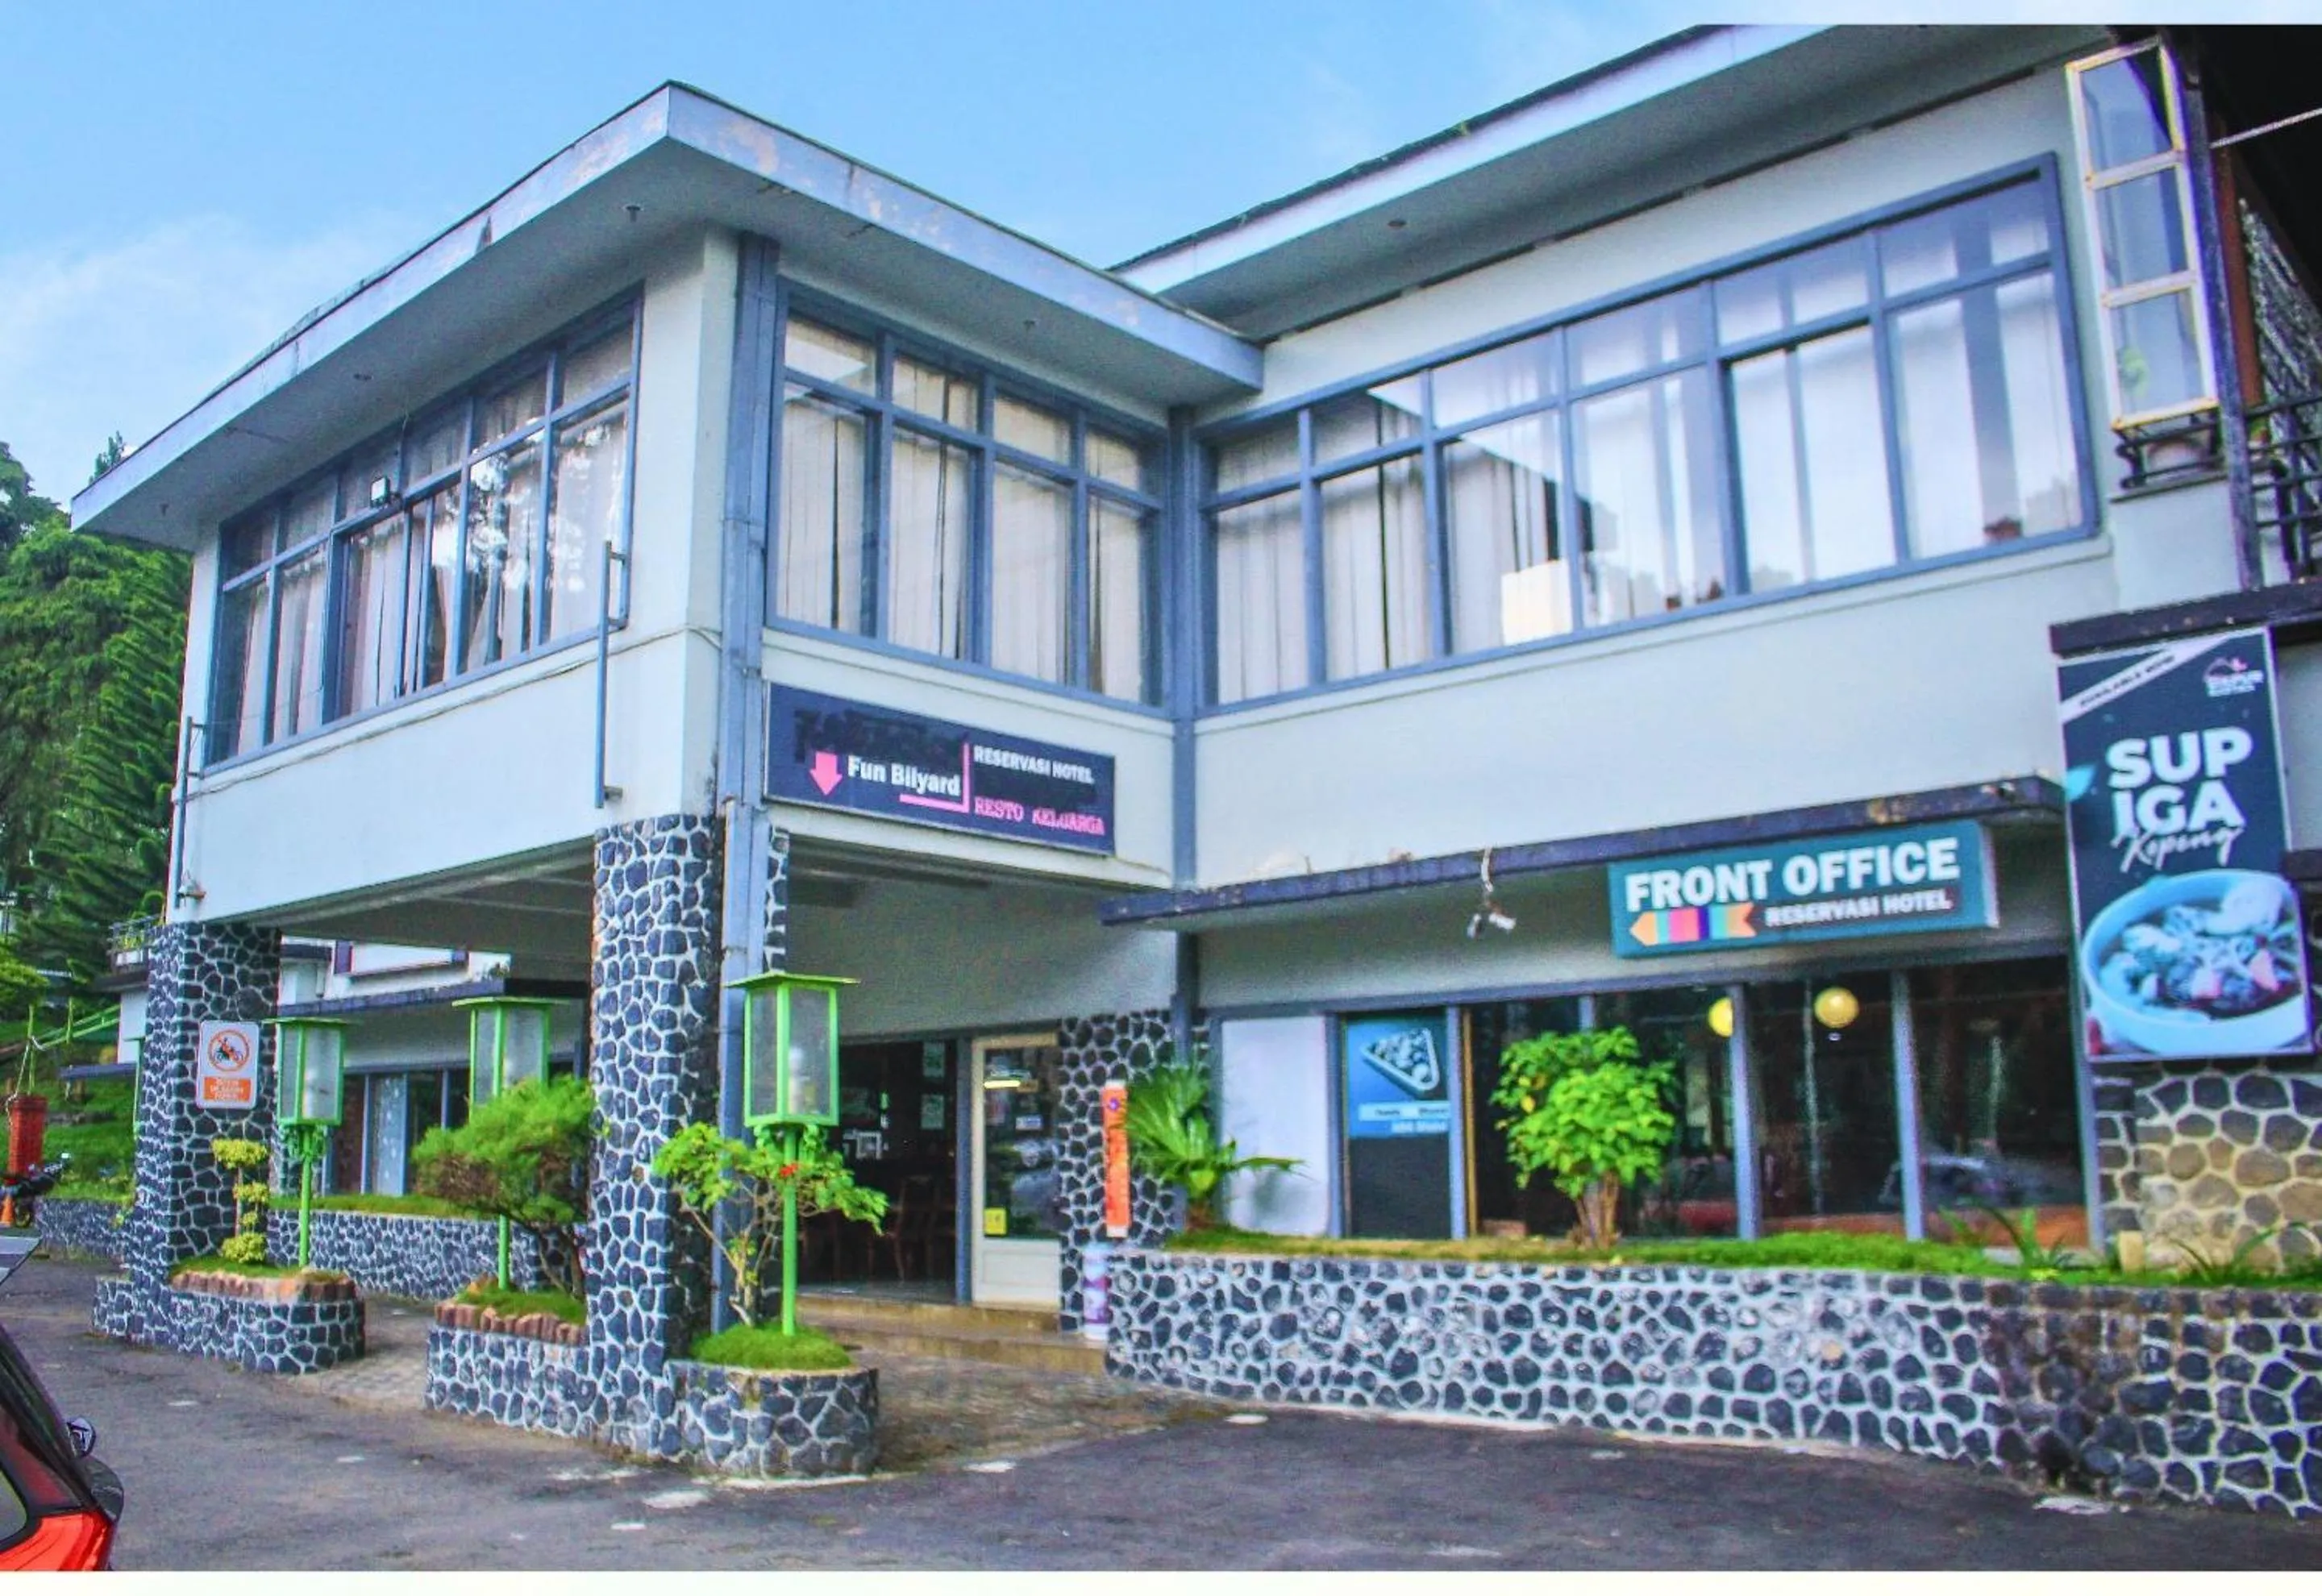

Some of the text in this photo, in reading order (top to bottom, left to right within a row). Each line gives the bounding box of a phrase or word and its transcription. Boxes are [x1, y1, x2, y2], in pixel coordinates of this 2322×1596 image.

[847, 756, 886, 783] Fun
[973, 745, 1094, 784] RESERVASI HOTEL
[2105, 727, 2253, 788] SUP
[974, 796, 1025, 822] RESTO
[2112, 780, 2246, 836] IGA
[1625, 837, 1960, 912] FRONT OFFICE
[1765, 888, 1953, 927] RESERVASI HOTEL
